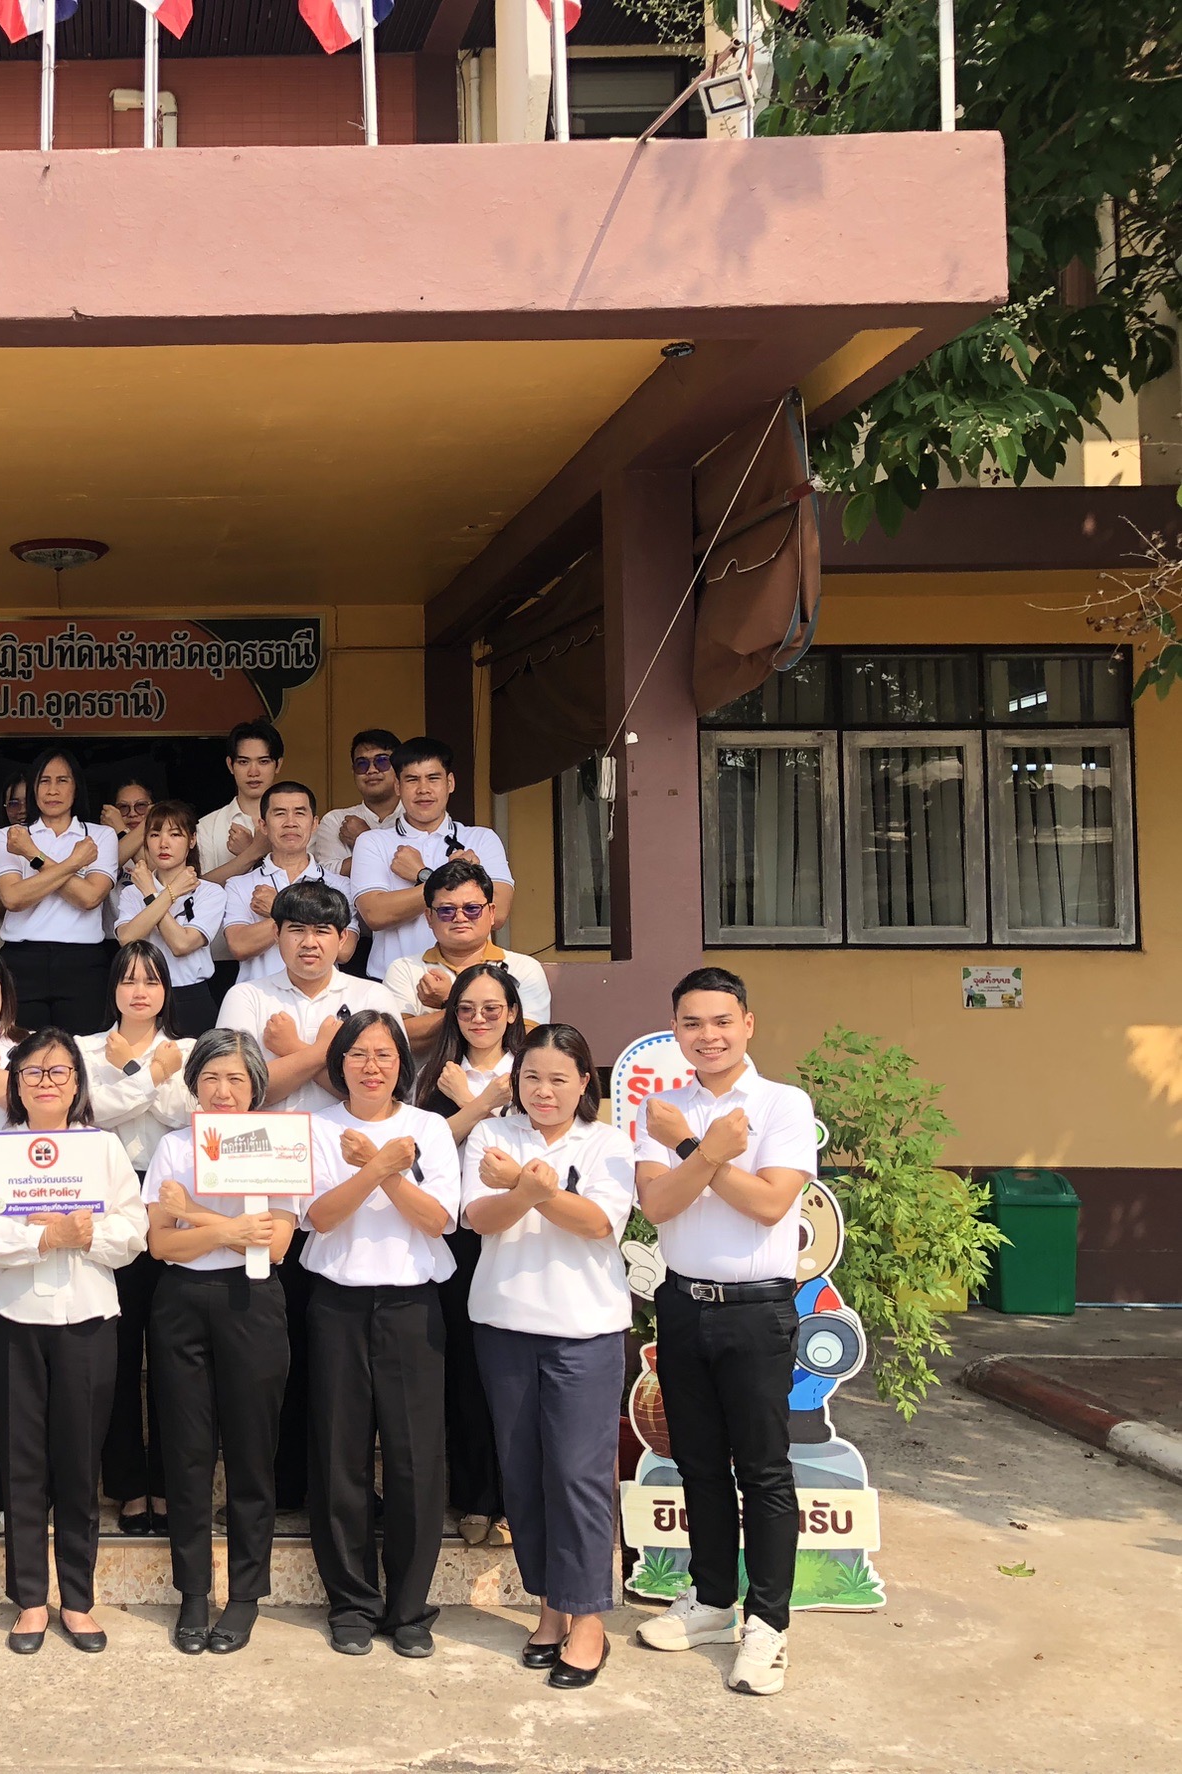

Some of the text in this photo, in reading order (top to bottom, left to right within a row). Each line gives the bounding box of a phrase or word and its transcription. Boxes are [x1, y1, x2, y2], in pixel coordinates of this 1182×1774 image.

[8, 1174, 83, 1185] การสร้างวัฒนธรรม
[12, 1186, 81, 1199] No Gift Policy
